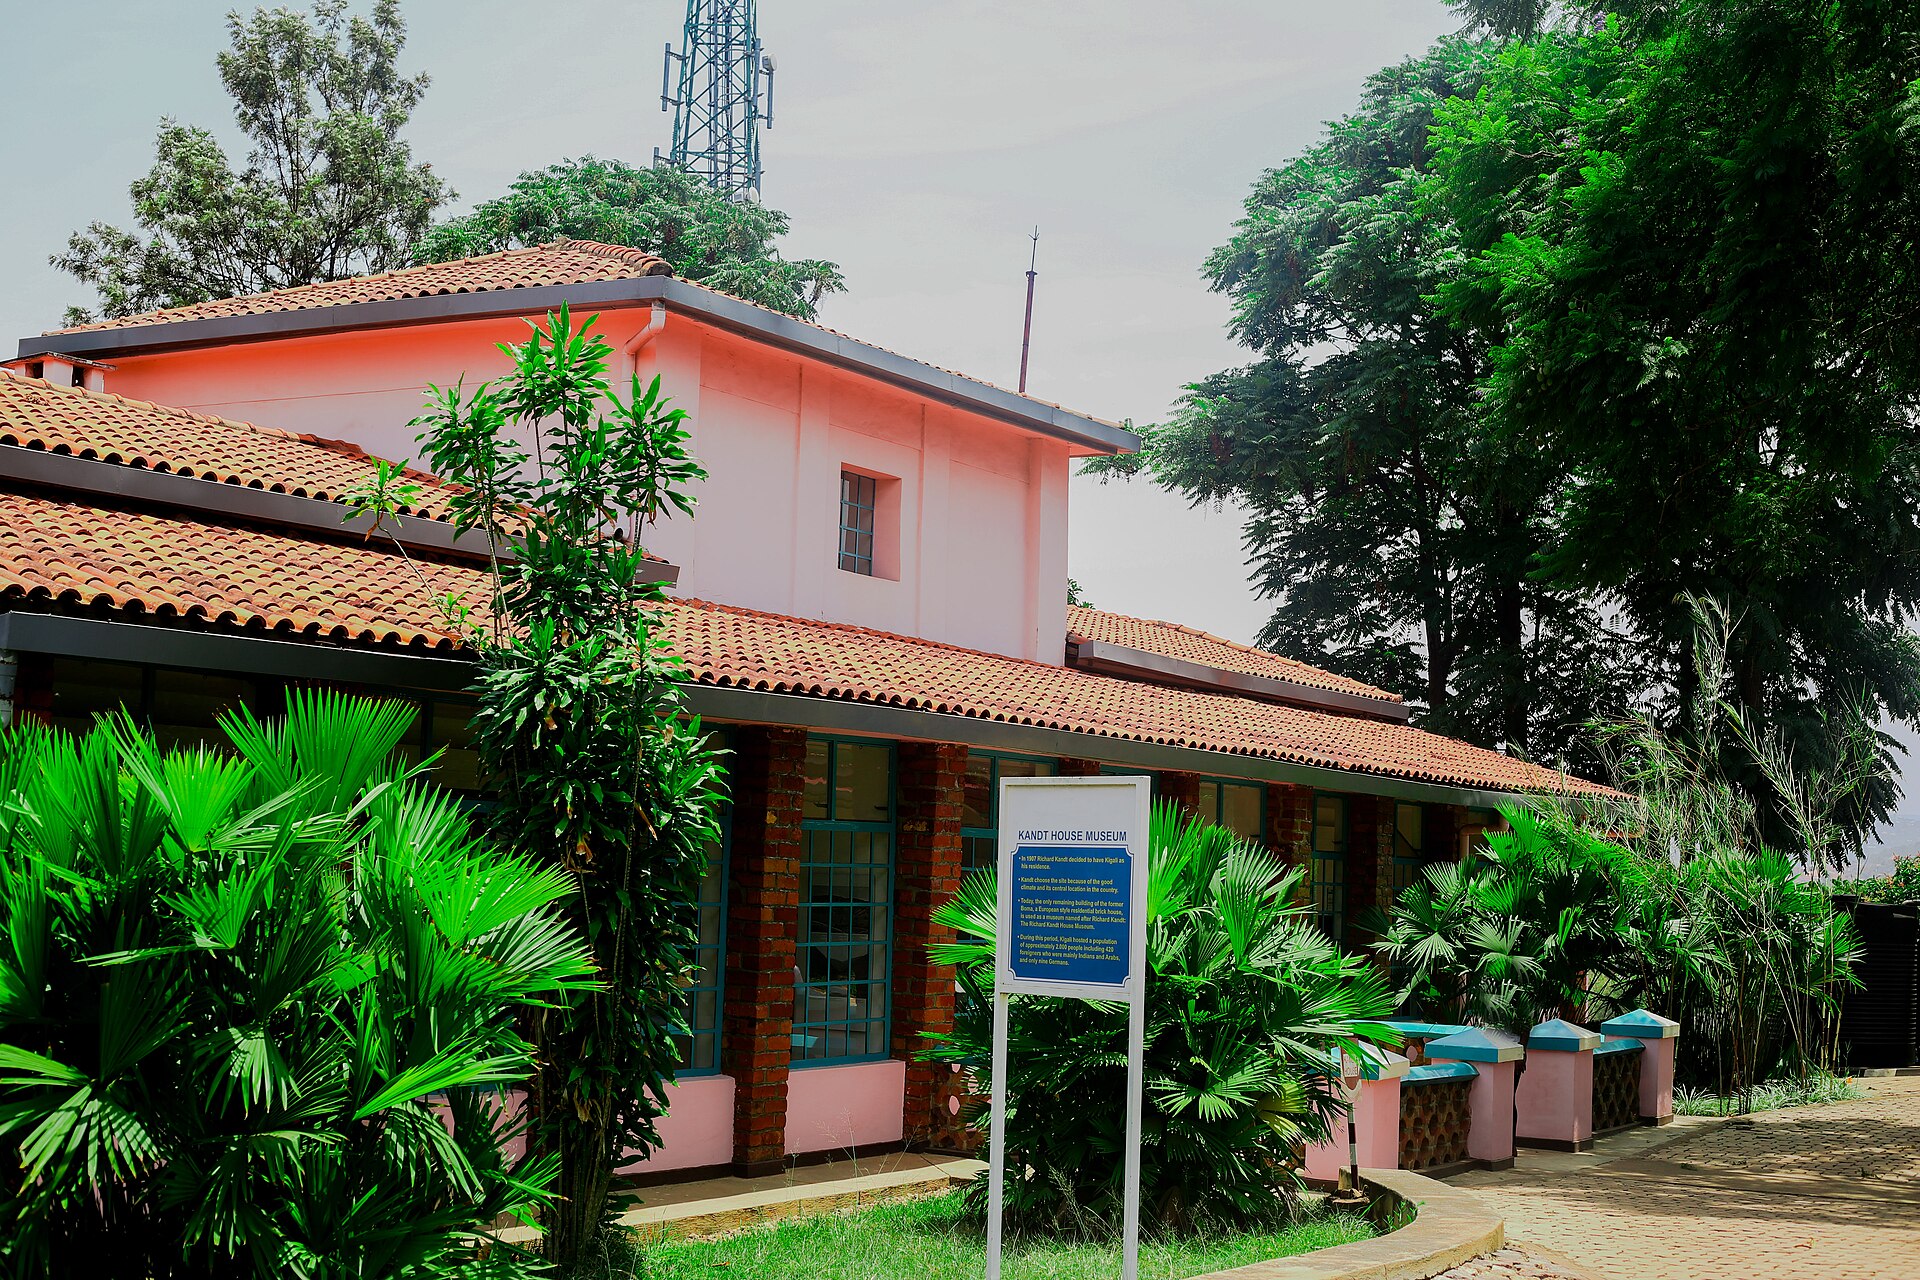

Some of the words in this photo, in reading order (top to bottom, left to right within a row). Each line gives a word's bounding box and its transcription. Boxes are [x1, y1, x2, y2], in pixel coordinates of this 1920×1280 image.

[1018, 830, 1048, 840] KANDT
[1051, 831, 1082, 840] HOUSE
[1086, 831, 1126, 841] MUSEUM
